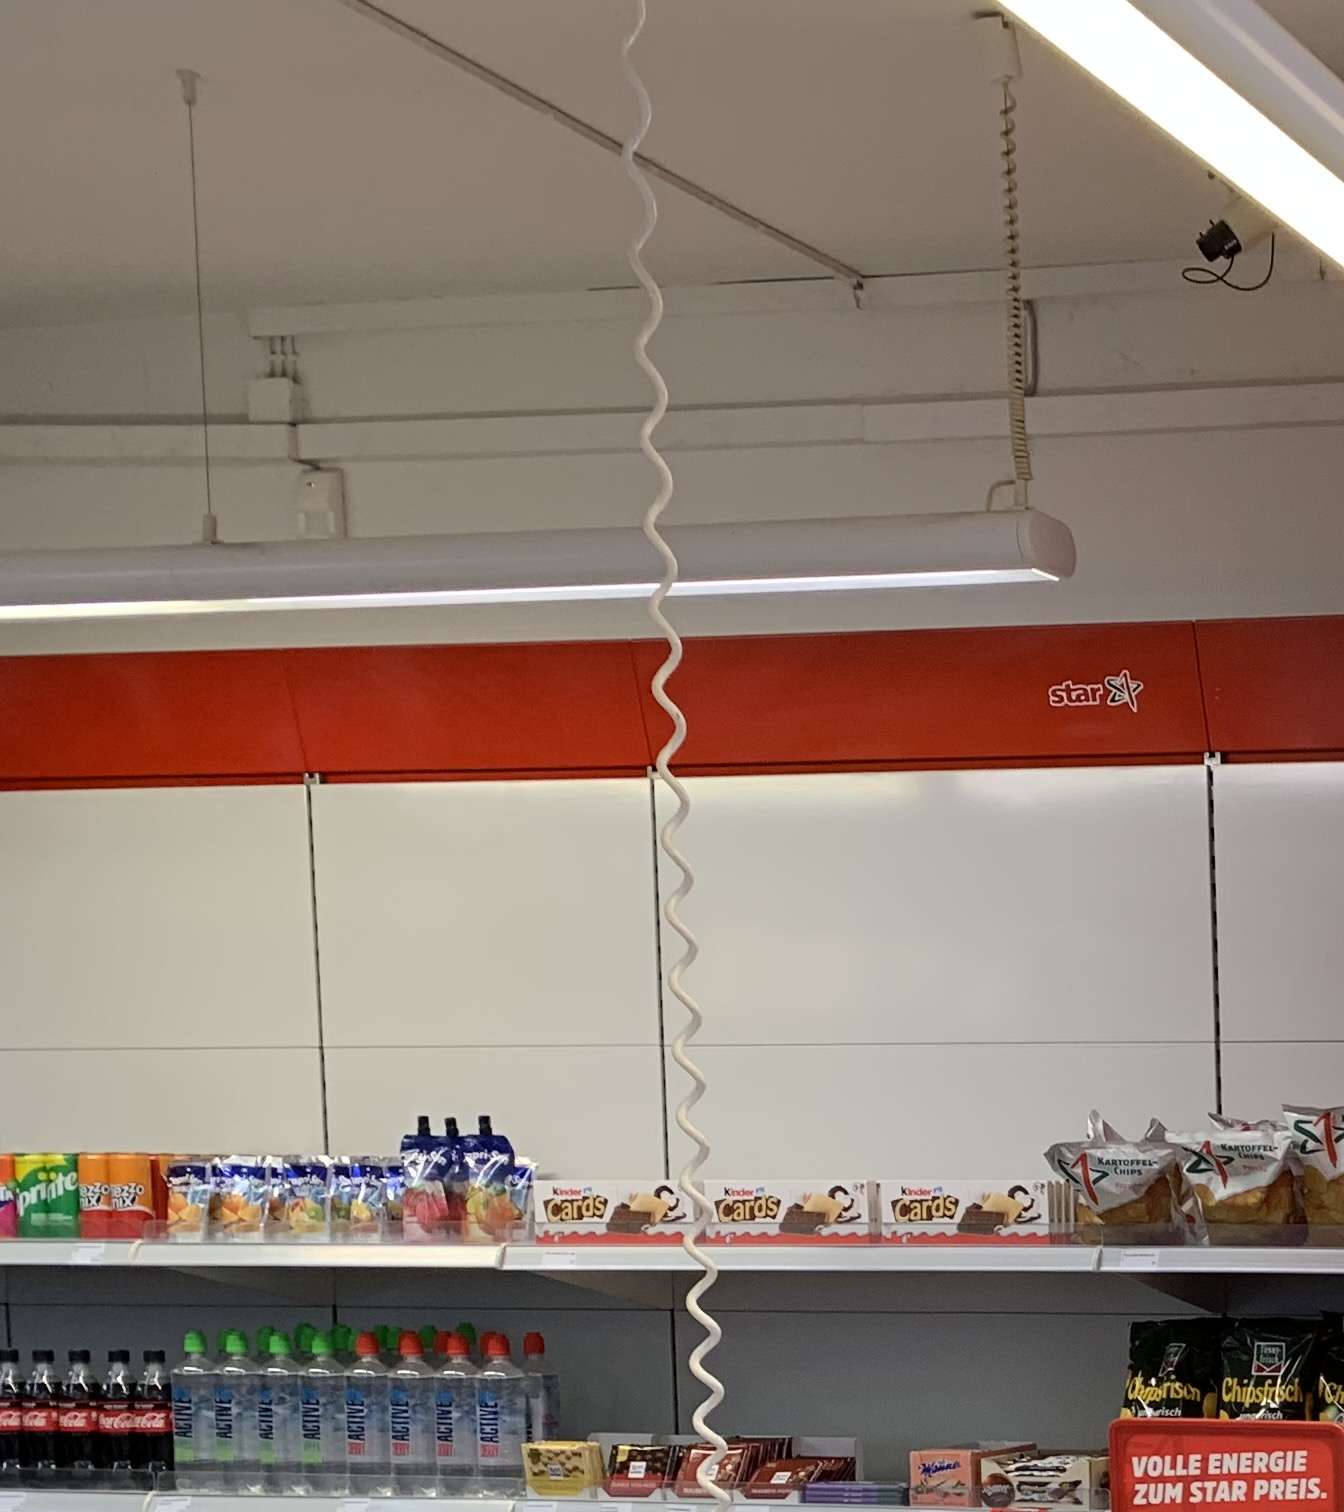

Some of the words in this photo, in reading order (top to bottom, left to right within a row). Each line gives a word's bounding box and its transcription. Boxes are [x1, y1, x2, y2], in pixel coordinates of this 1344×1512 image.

[1049, 680, 1103, 706] star
[1239, 1152, 1264, 1160] CHIPS
[1114, 1167, 1143, 1175] CHIPS
[547, 1197, 607, 1221] Cards
[718, 1197, 778, 1221] Cards
[894, 1197, 955, 1221] Cards
[1132, 1455, 1202, 1478] VOLLE
[1208, 1451, 1307, 1474] ENERGIE
[1133, 1481, 1182, 1505] ZUM
[1189, 1479, 1246, 1503] STAR
[1254, 1477, 1328, 1501] PREIS.
